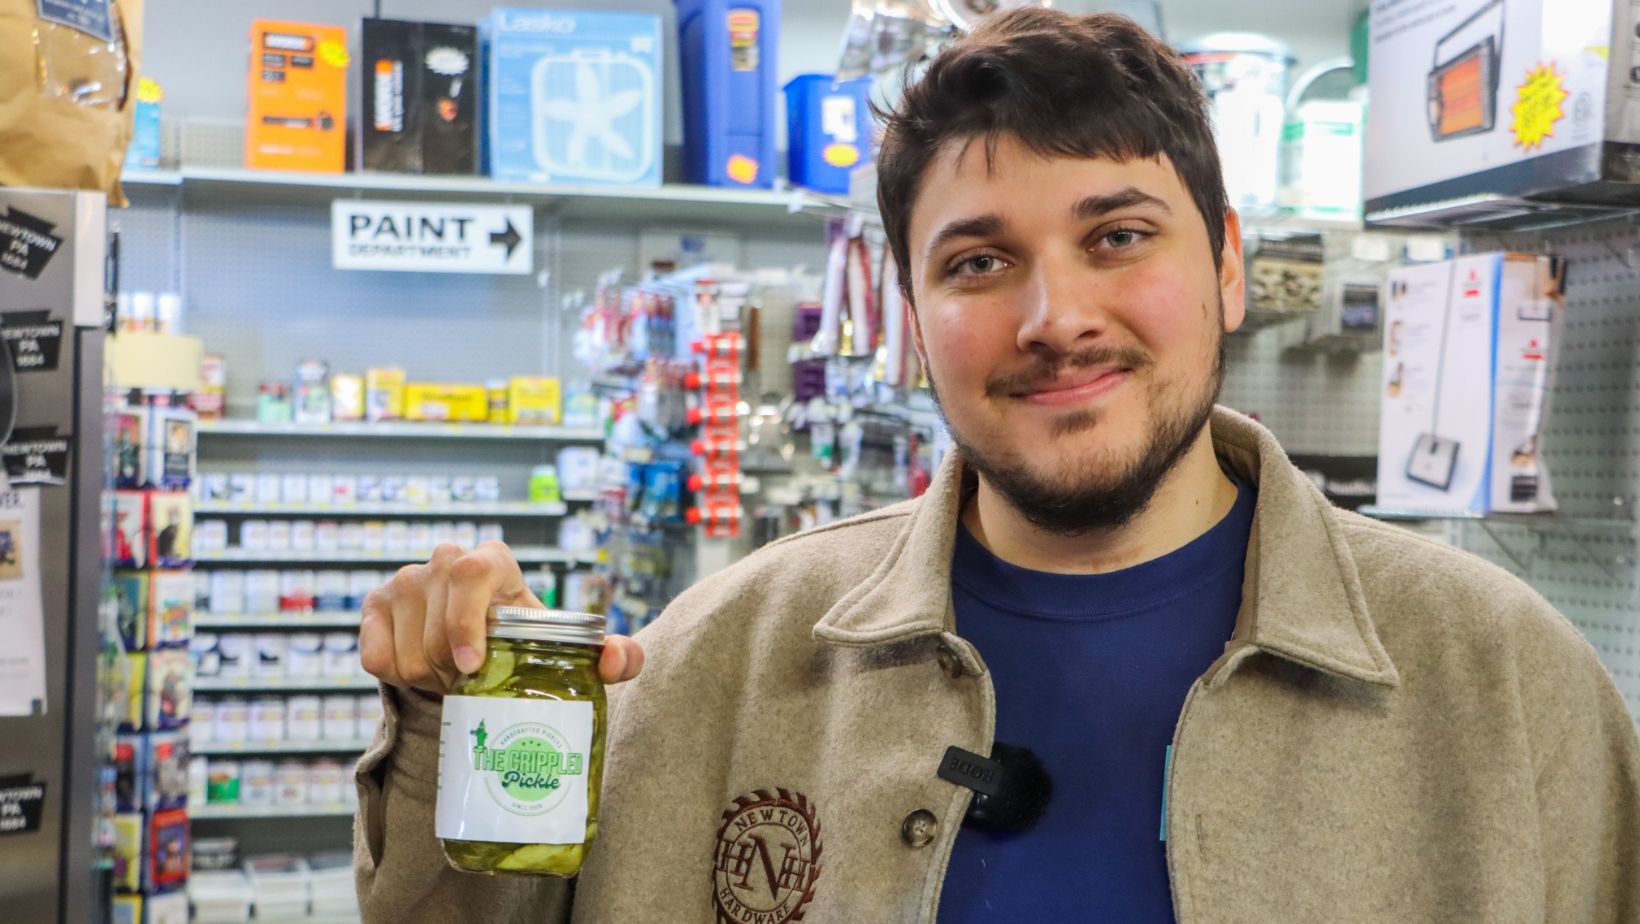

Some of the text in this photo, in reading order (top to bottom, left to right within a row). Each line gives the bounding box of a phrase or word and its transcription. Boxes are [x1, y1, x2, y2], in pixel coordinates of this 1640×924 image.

[498, 10, 577, 33] Lasko
[349, 214, 476, 240] PAINT
[10, 239, 29, 257] PA
[350, 243, 473, 260] DEPARTMENT
[19, 338, 40, 353] PA
[26, 454, 47, 468] PA
[473, 747, 505, 771] THE
[501, 770, 561, 789] Pickle
[2, 803, 21, 817] PA
[735, 808, 809, 848] NEWTOWN
[719, 888, 791, 924] HARDWARE
